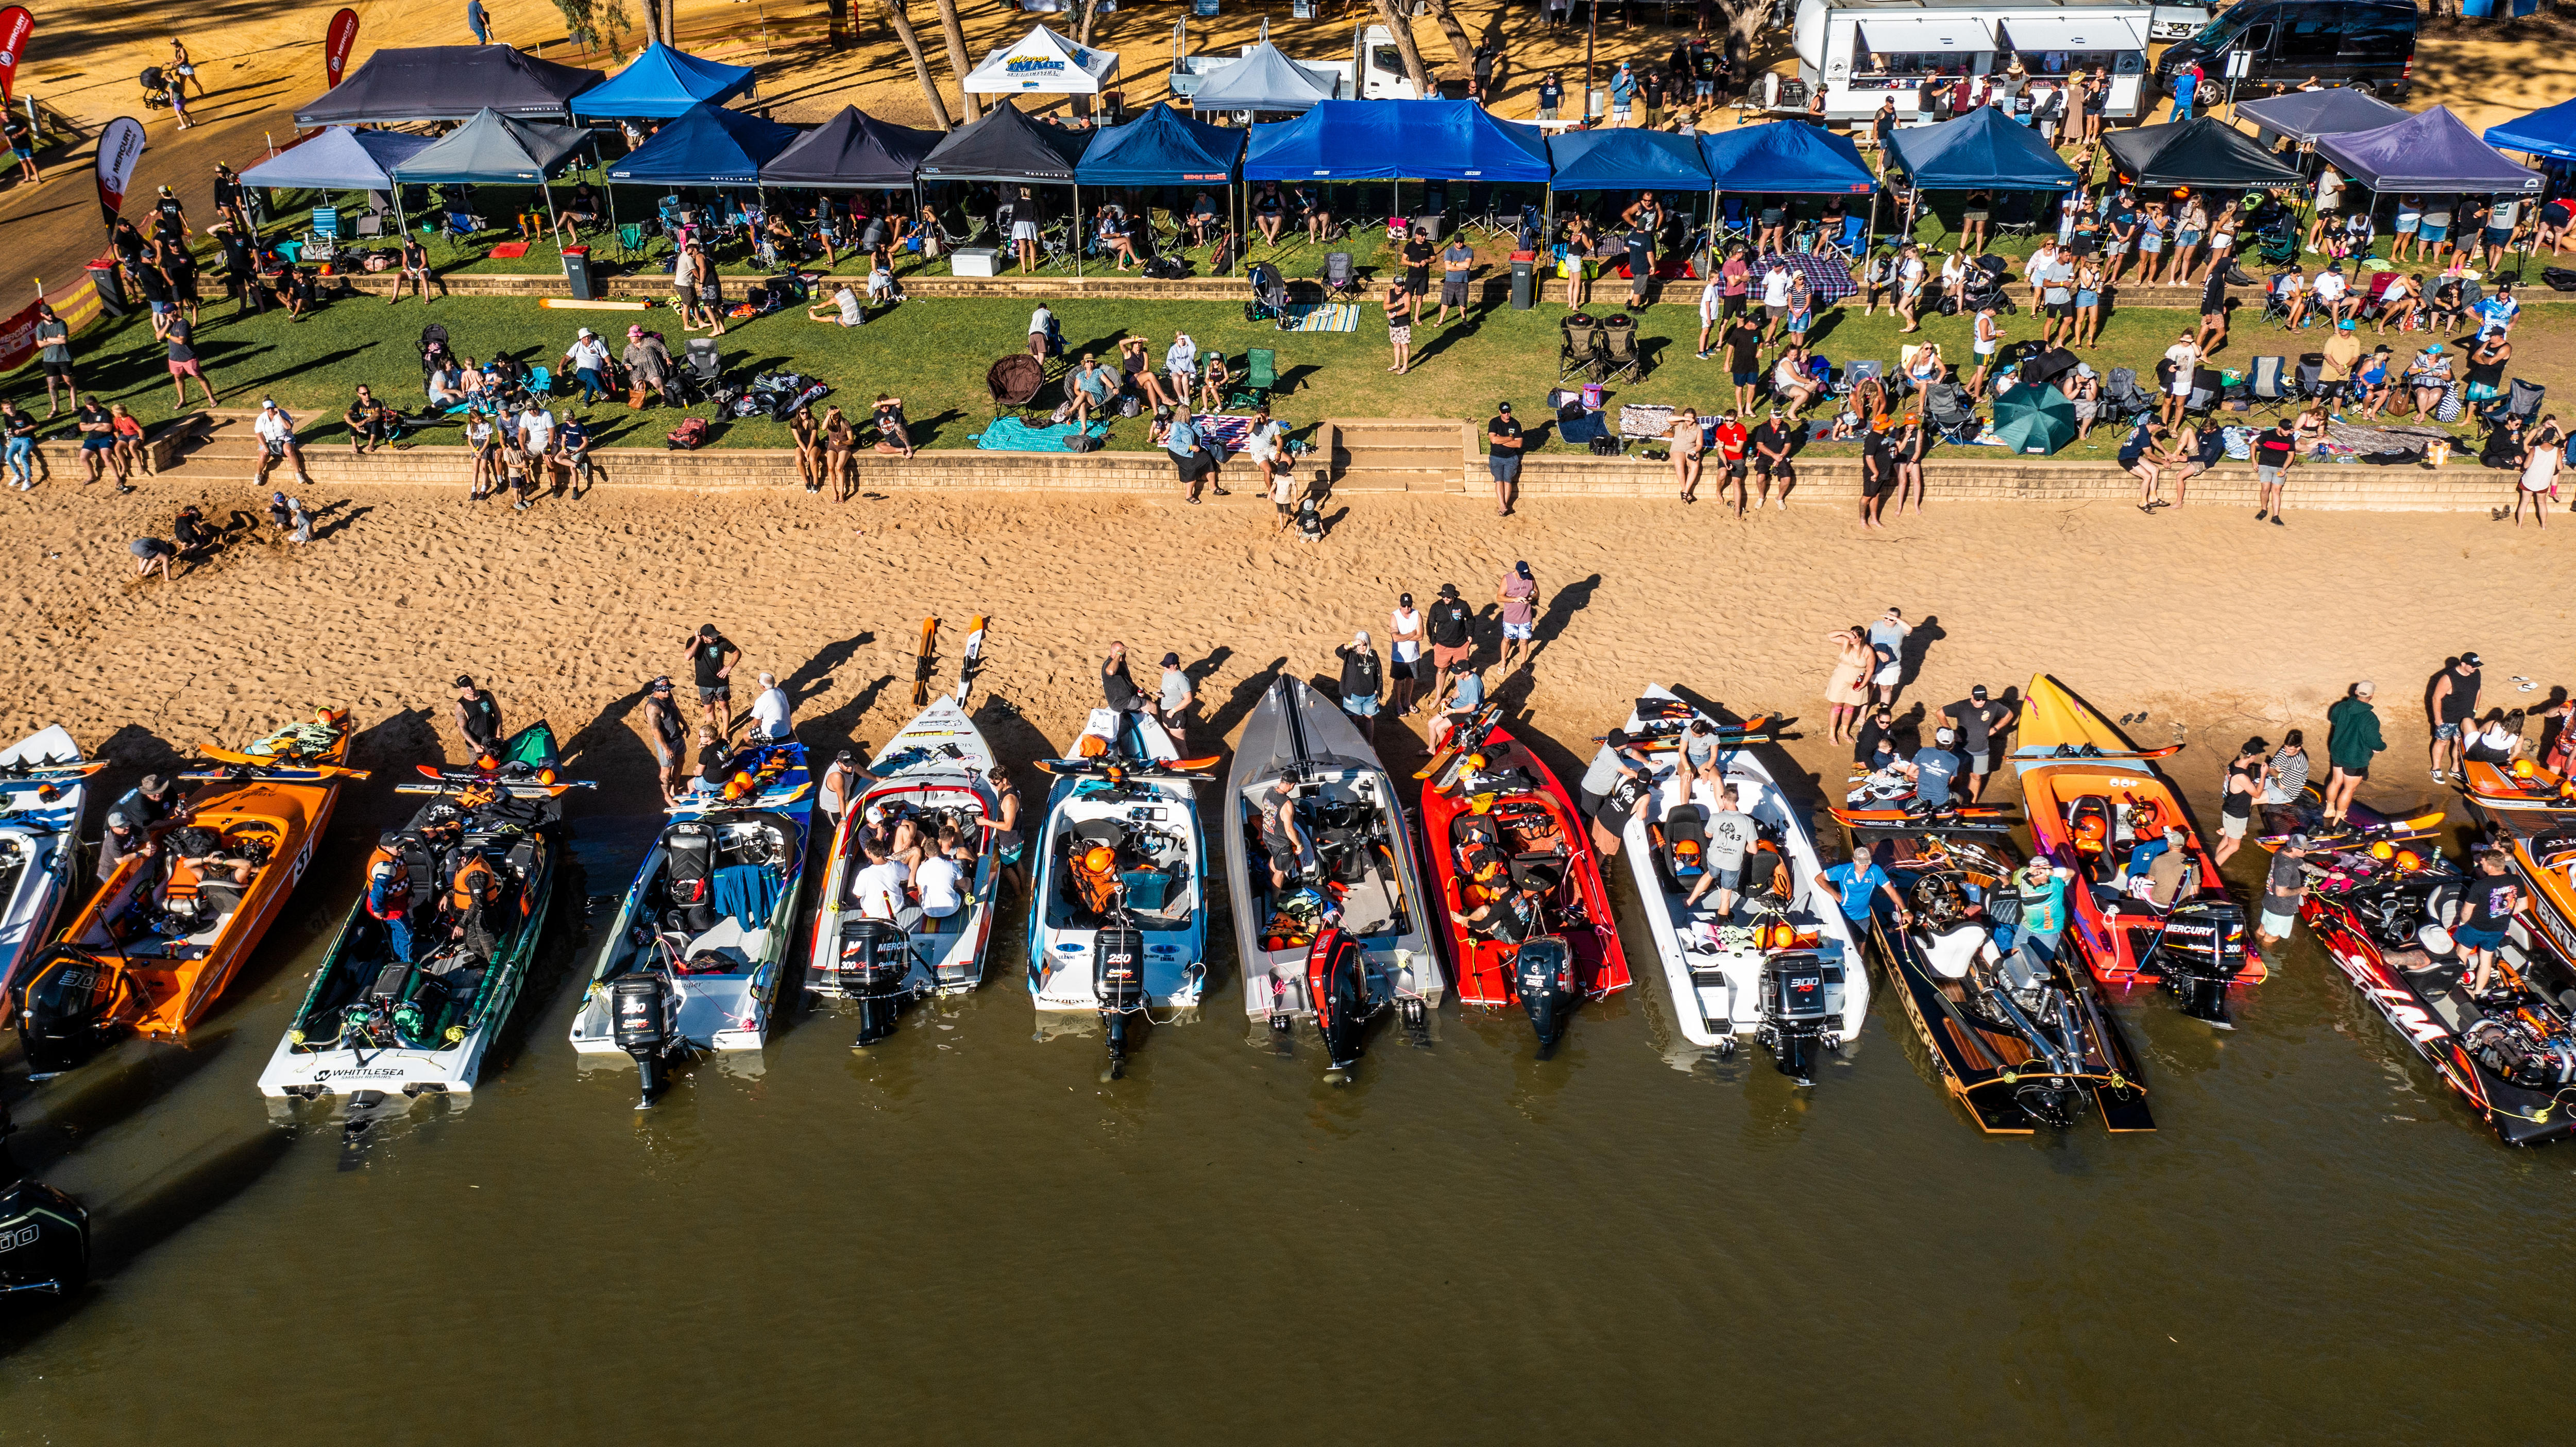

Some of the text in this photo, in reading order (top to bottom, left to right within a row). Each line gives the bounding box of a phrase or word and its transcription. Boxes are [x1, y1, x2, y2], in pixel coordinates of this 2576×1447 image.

[7, 12, 26, 52] MERCURY
[337, 16, 353, 56] MERCURY
[1006, 55, 1050, 65] Mirror
[1007, 60, 1064, 72] IMAGE
[113, 126, 132, 174] MERCURY
[126, 133, 137, 157] Finance
[2165, 924, 2216, 937] MERCURY
[877, 941, 911, 952] MERCURY
[1107, 954, 1132, 964] 250
[59, 971, 109, 992] 300
[1790, 977, 1819, 988] 300
[1798, 984, 1814, 993] XS
[621, 1002, 646, 1014] 250
